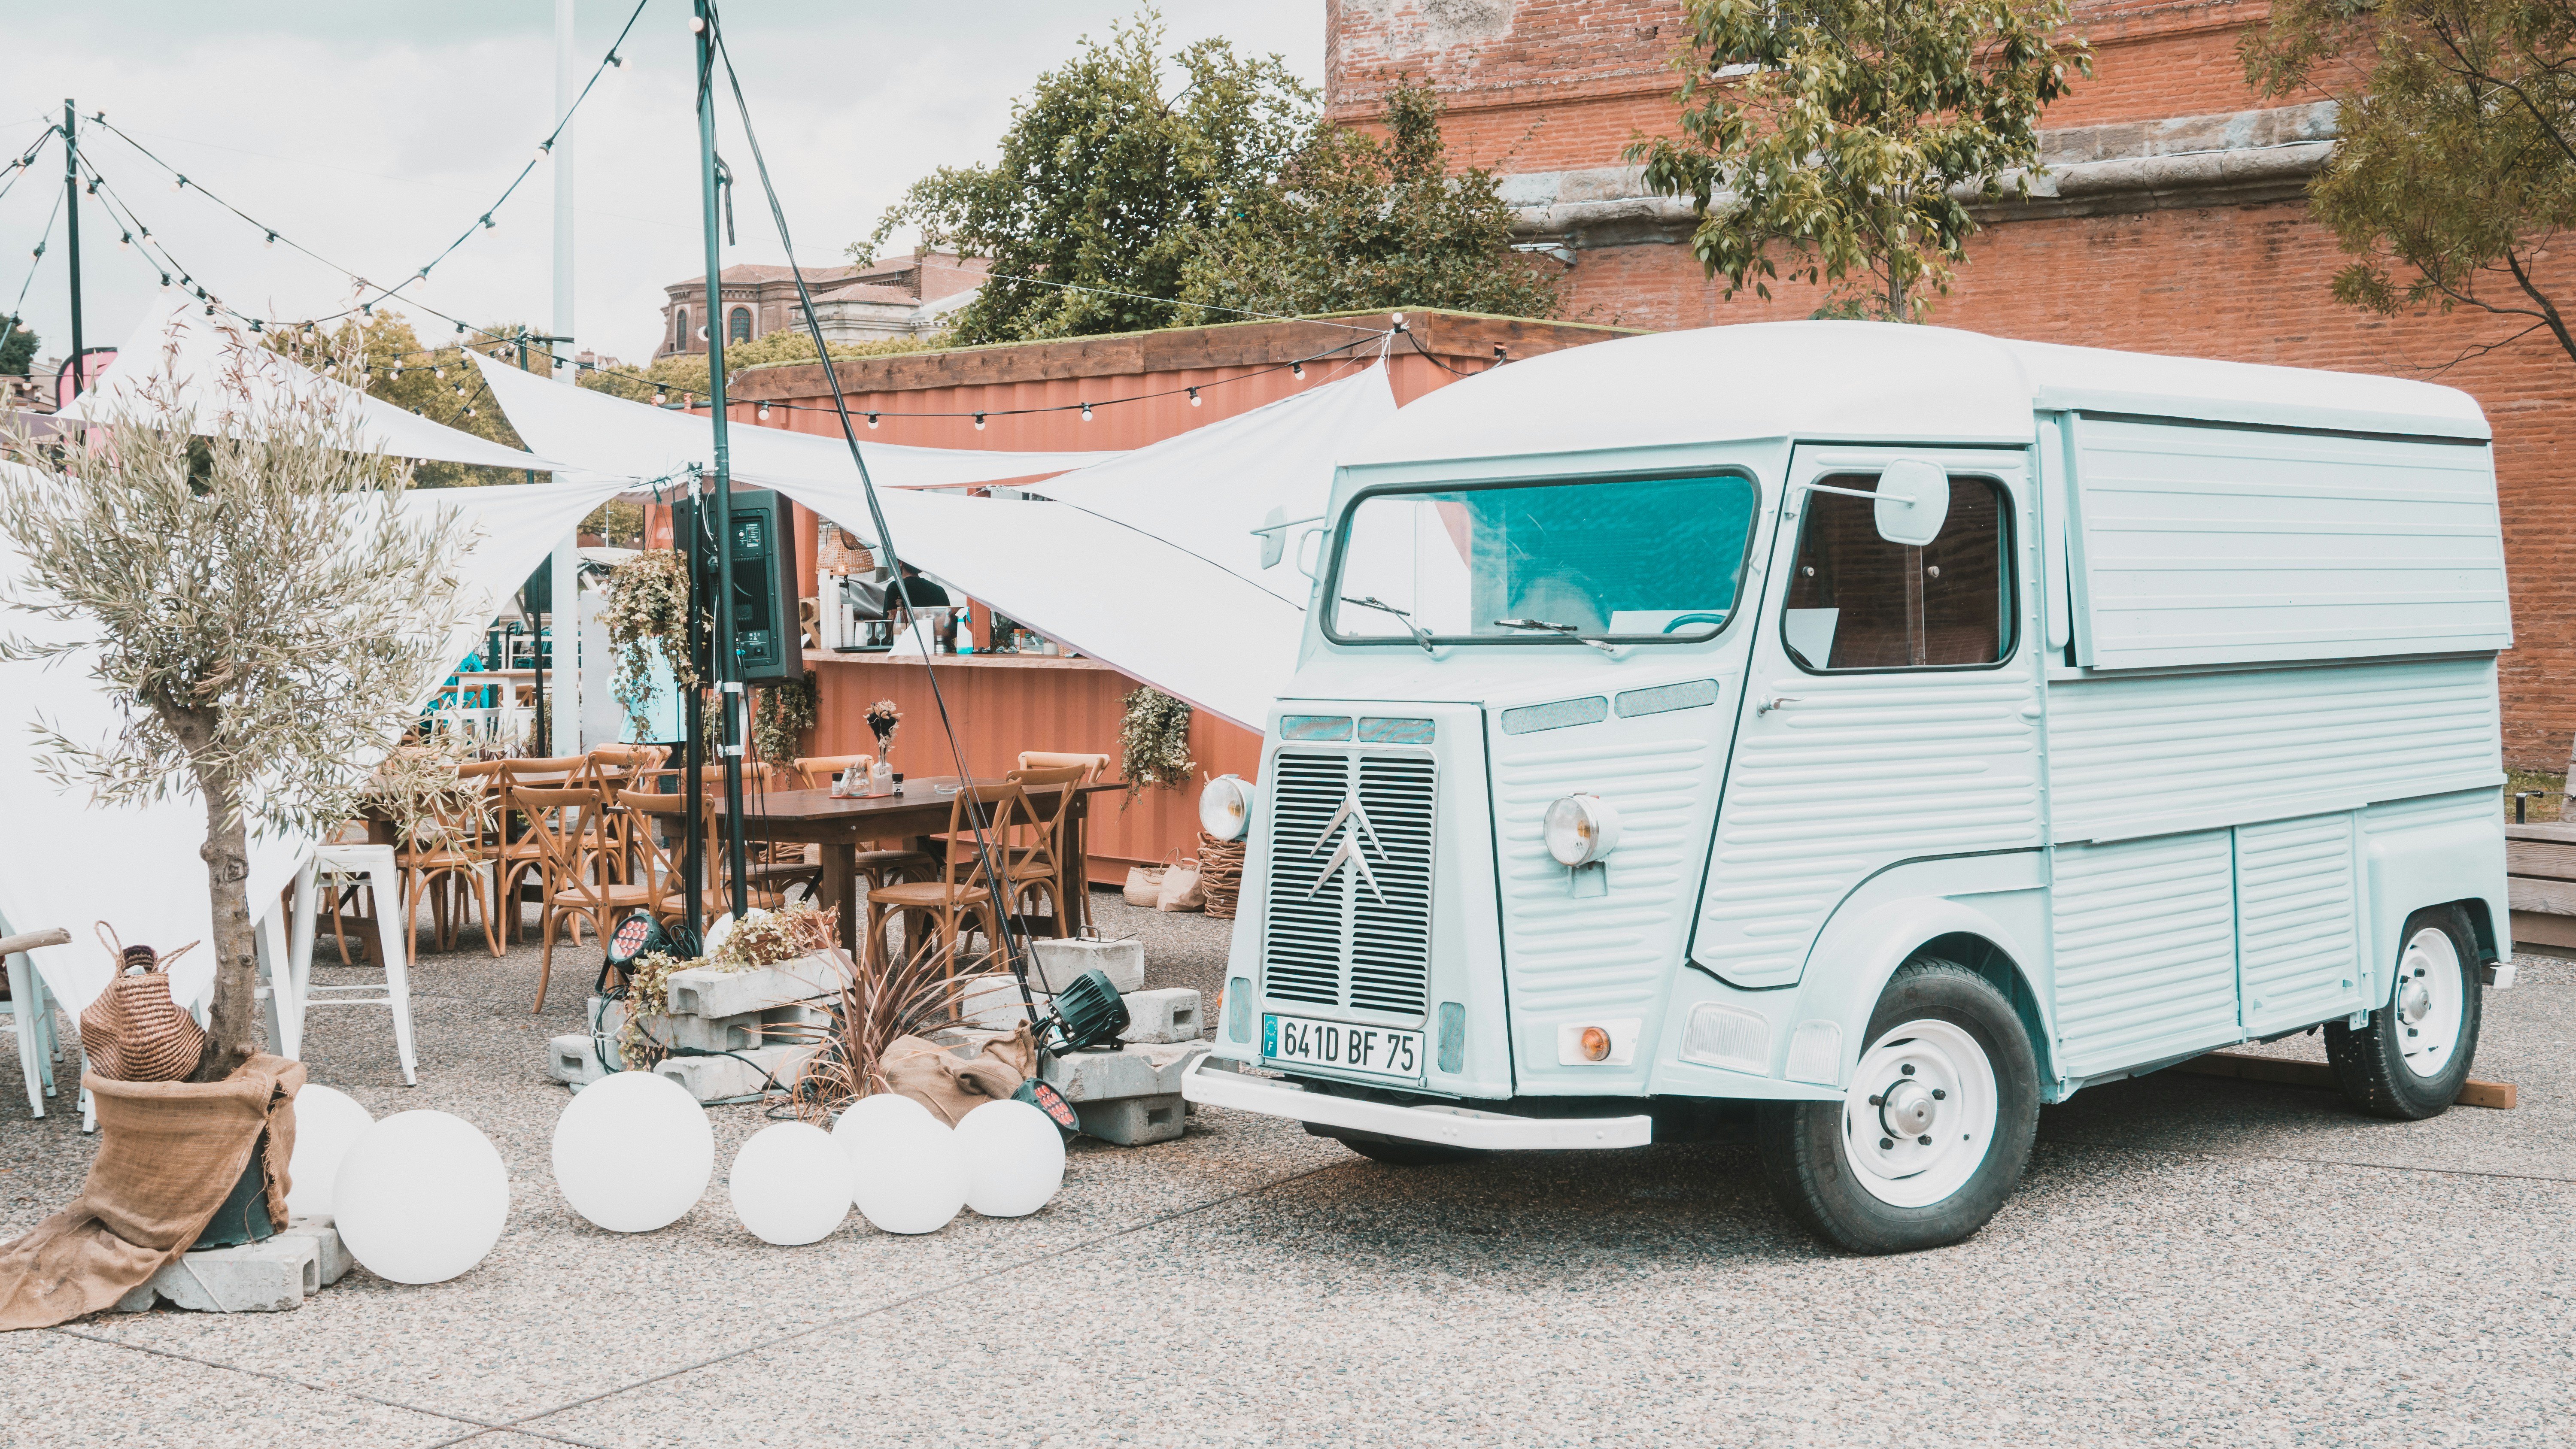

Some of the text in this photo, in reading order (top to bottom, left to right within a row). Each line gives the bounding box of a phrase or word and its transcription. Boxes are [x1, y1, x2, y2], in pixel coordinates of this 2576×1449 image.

[1268, 1041, 1273, 1051] F
[1285, 1022, 1413, 1071] 641D BF 75
